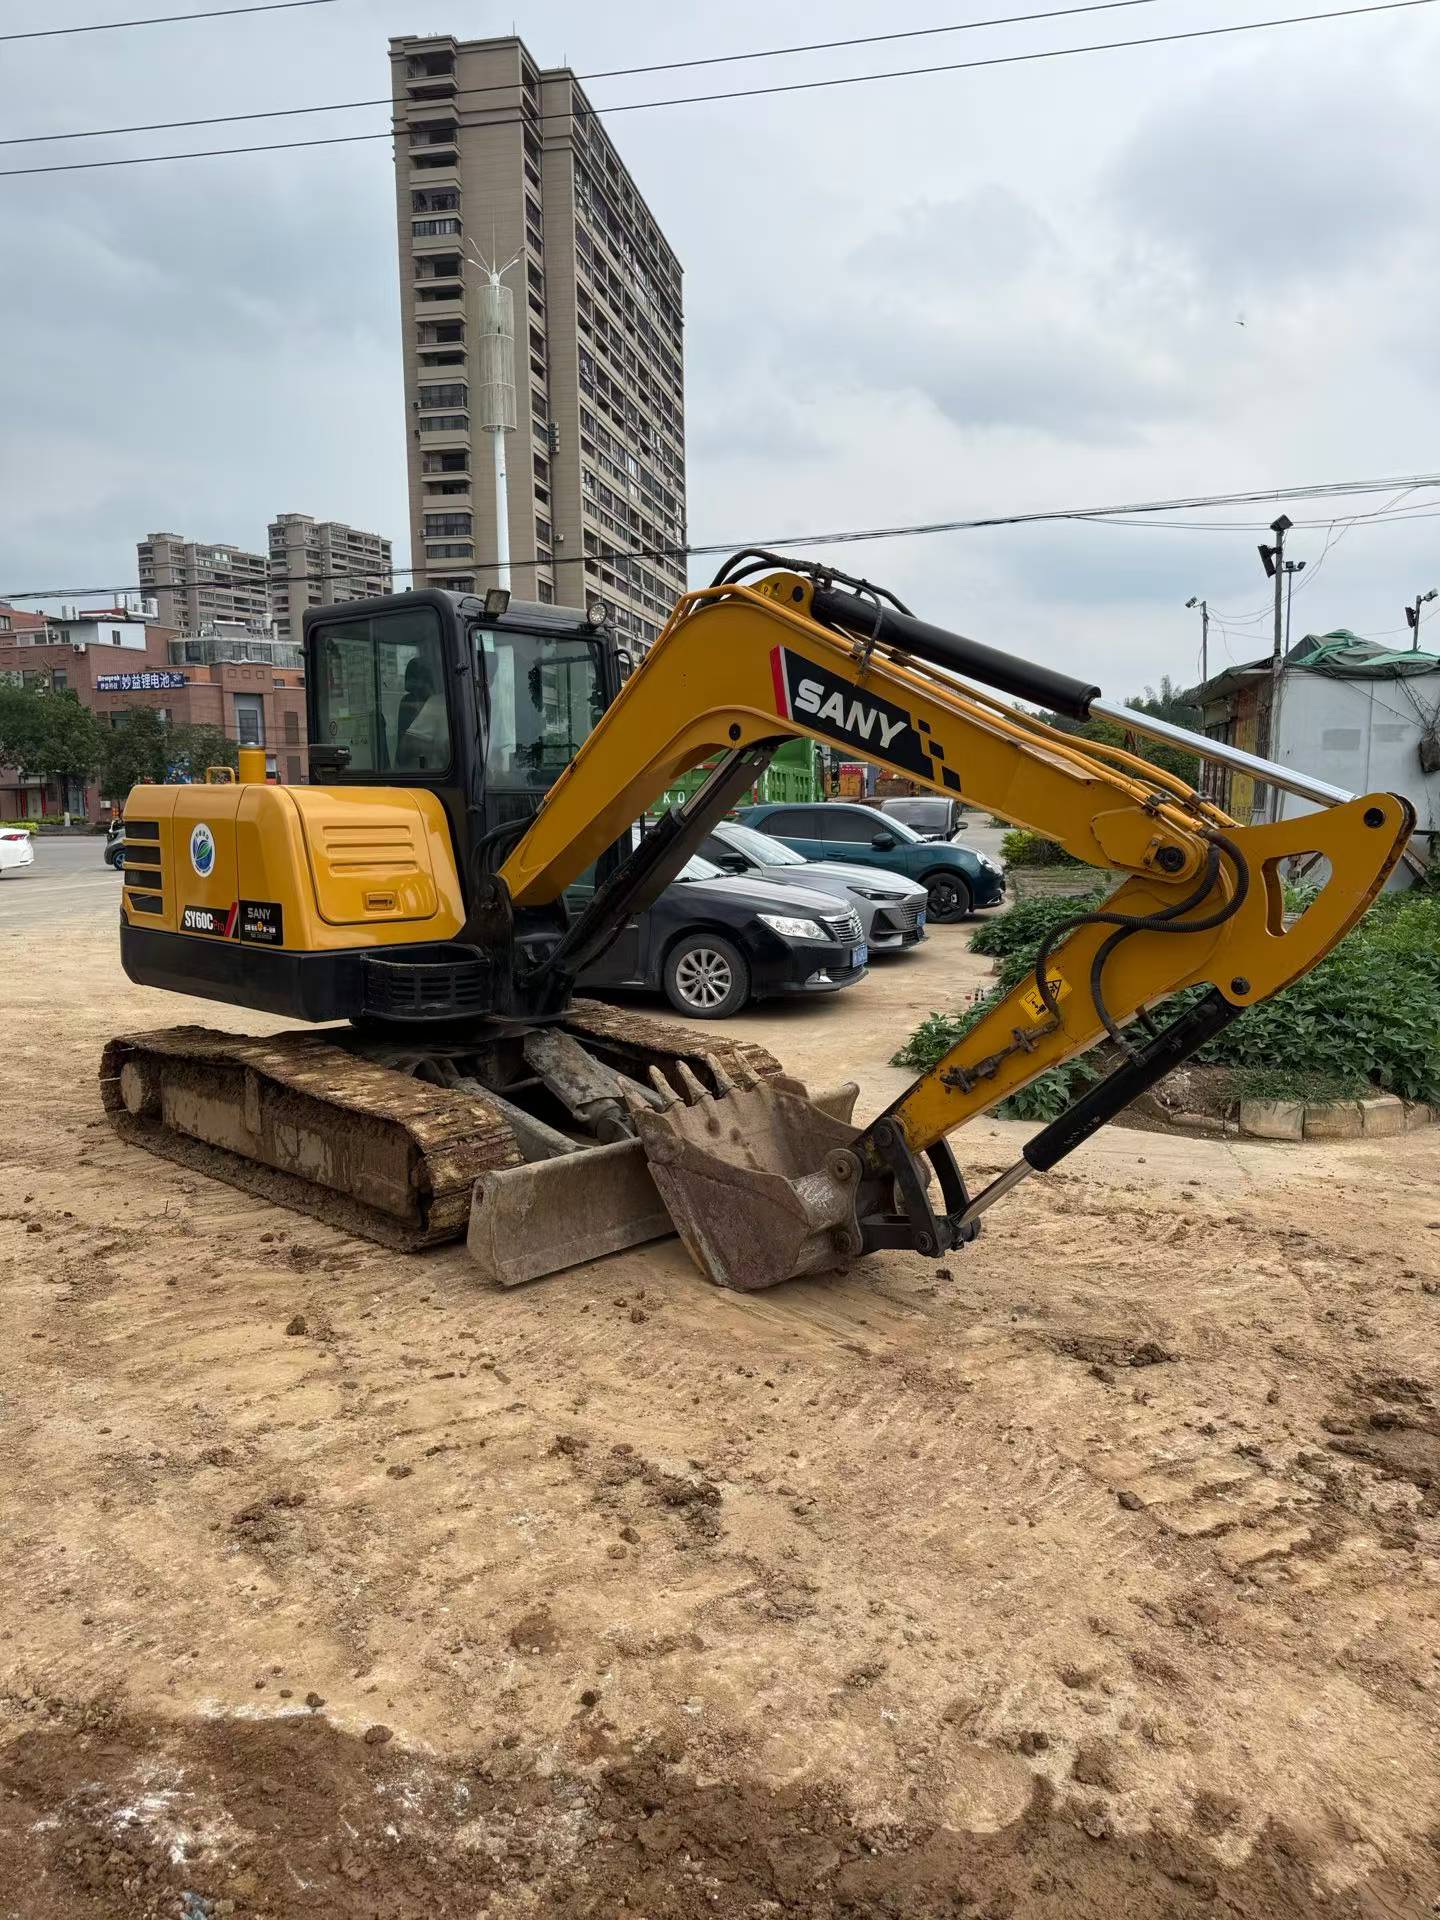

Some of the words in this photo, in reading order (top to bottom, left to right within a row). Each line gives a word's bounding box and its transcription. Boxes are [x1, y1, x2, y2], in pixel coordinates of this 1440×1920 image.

[122, 673, 170, 690] 妙益锂电池
[794, 678, 908, 749] SANY
[184, 910, 214, 931] SY60C
[247, 907, 271, 921] SANY
